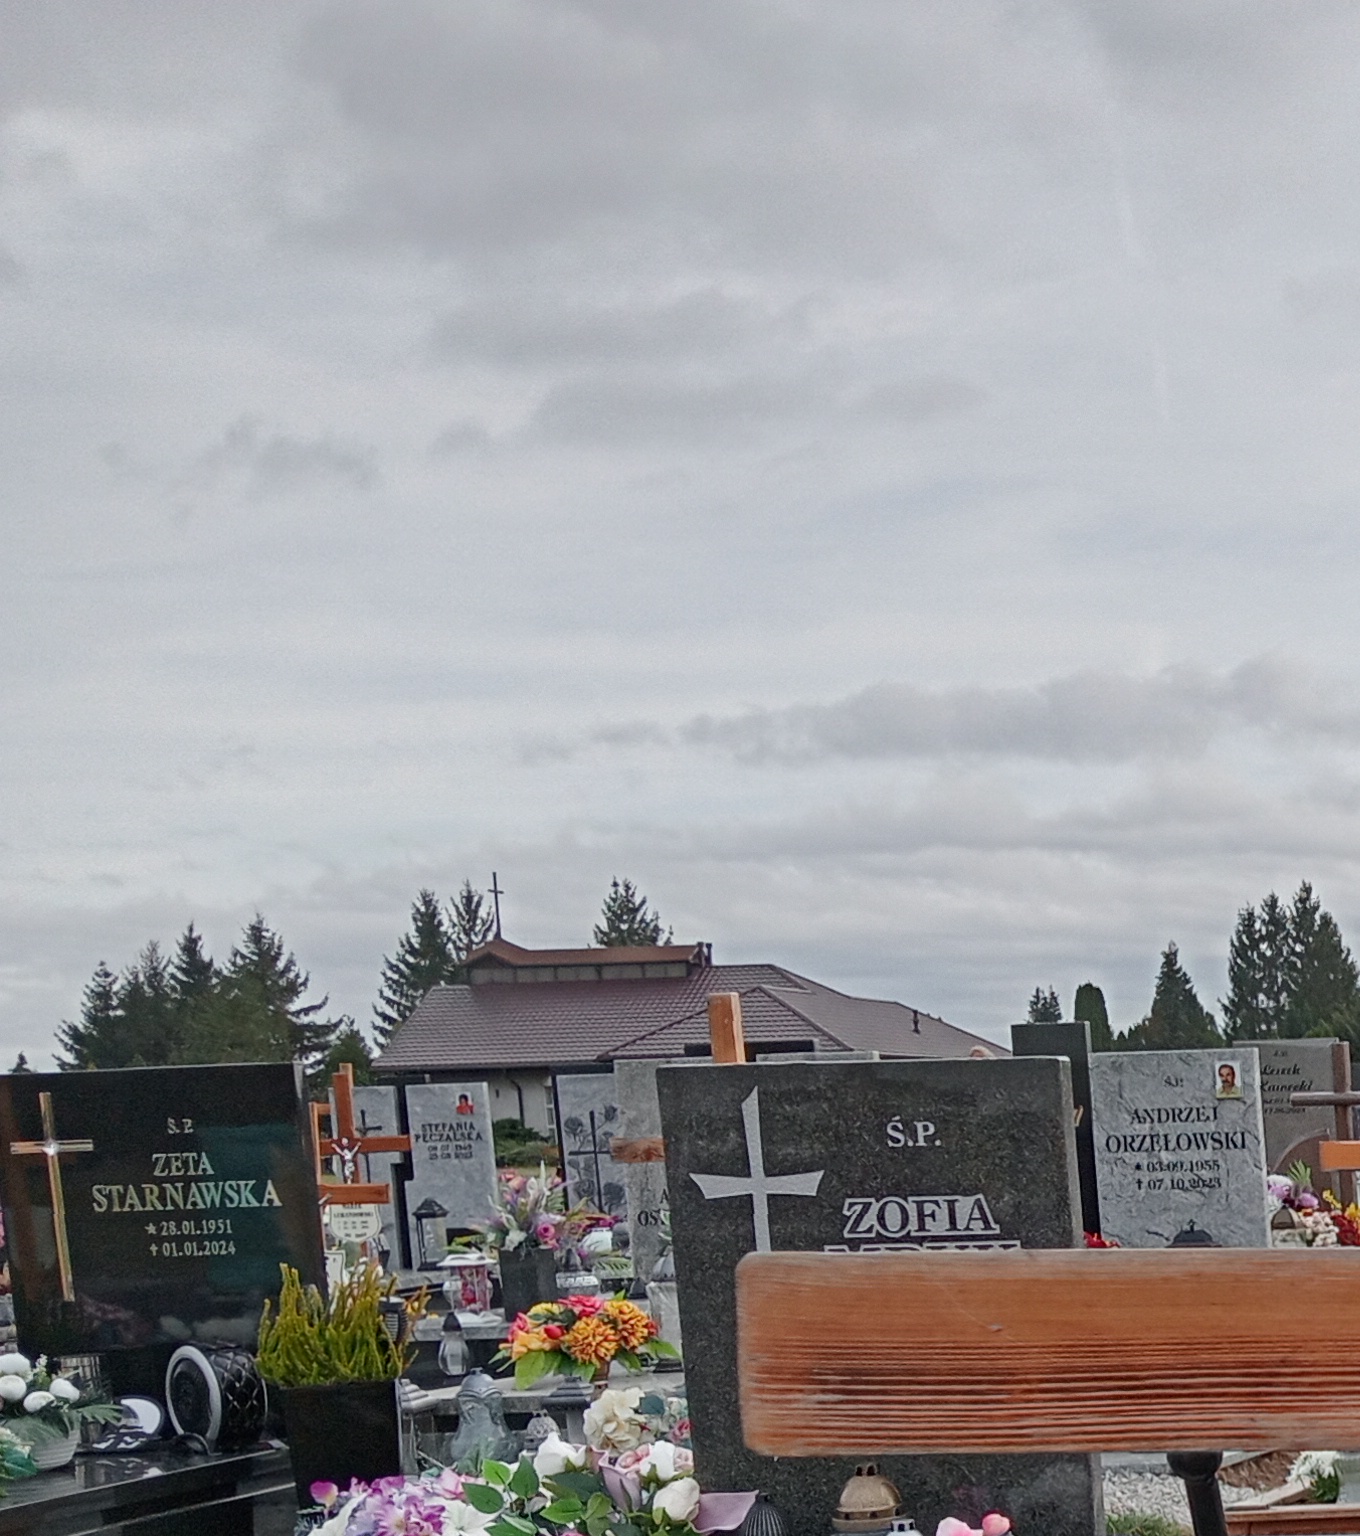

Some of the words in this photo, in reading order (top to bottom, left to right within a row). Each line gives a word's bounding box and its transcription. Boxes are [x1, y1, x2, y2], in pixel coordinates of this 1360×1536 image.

[1130, 1105, 1219, 1125] ANDRZEJ
[421, 1121, 476, 1134] STEFANIA
[886, 1116, 942, 1148] Ś.P.
[152, 1151, 215, 1177] ZETA
[92, 1179, 283, 1212] STARNAWSKA
[160, 1219, 233, 1236] 28.01.1951
[842, 1194, 1000, 1238] ZOFIA
[162, 1241, 236, 1257] 01.01.2024
